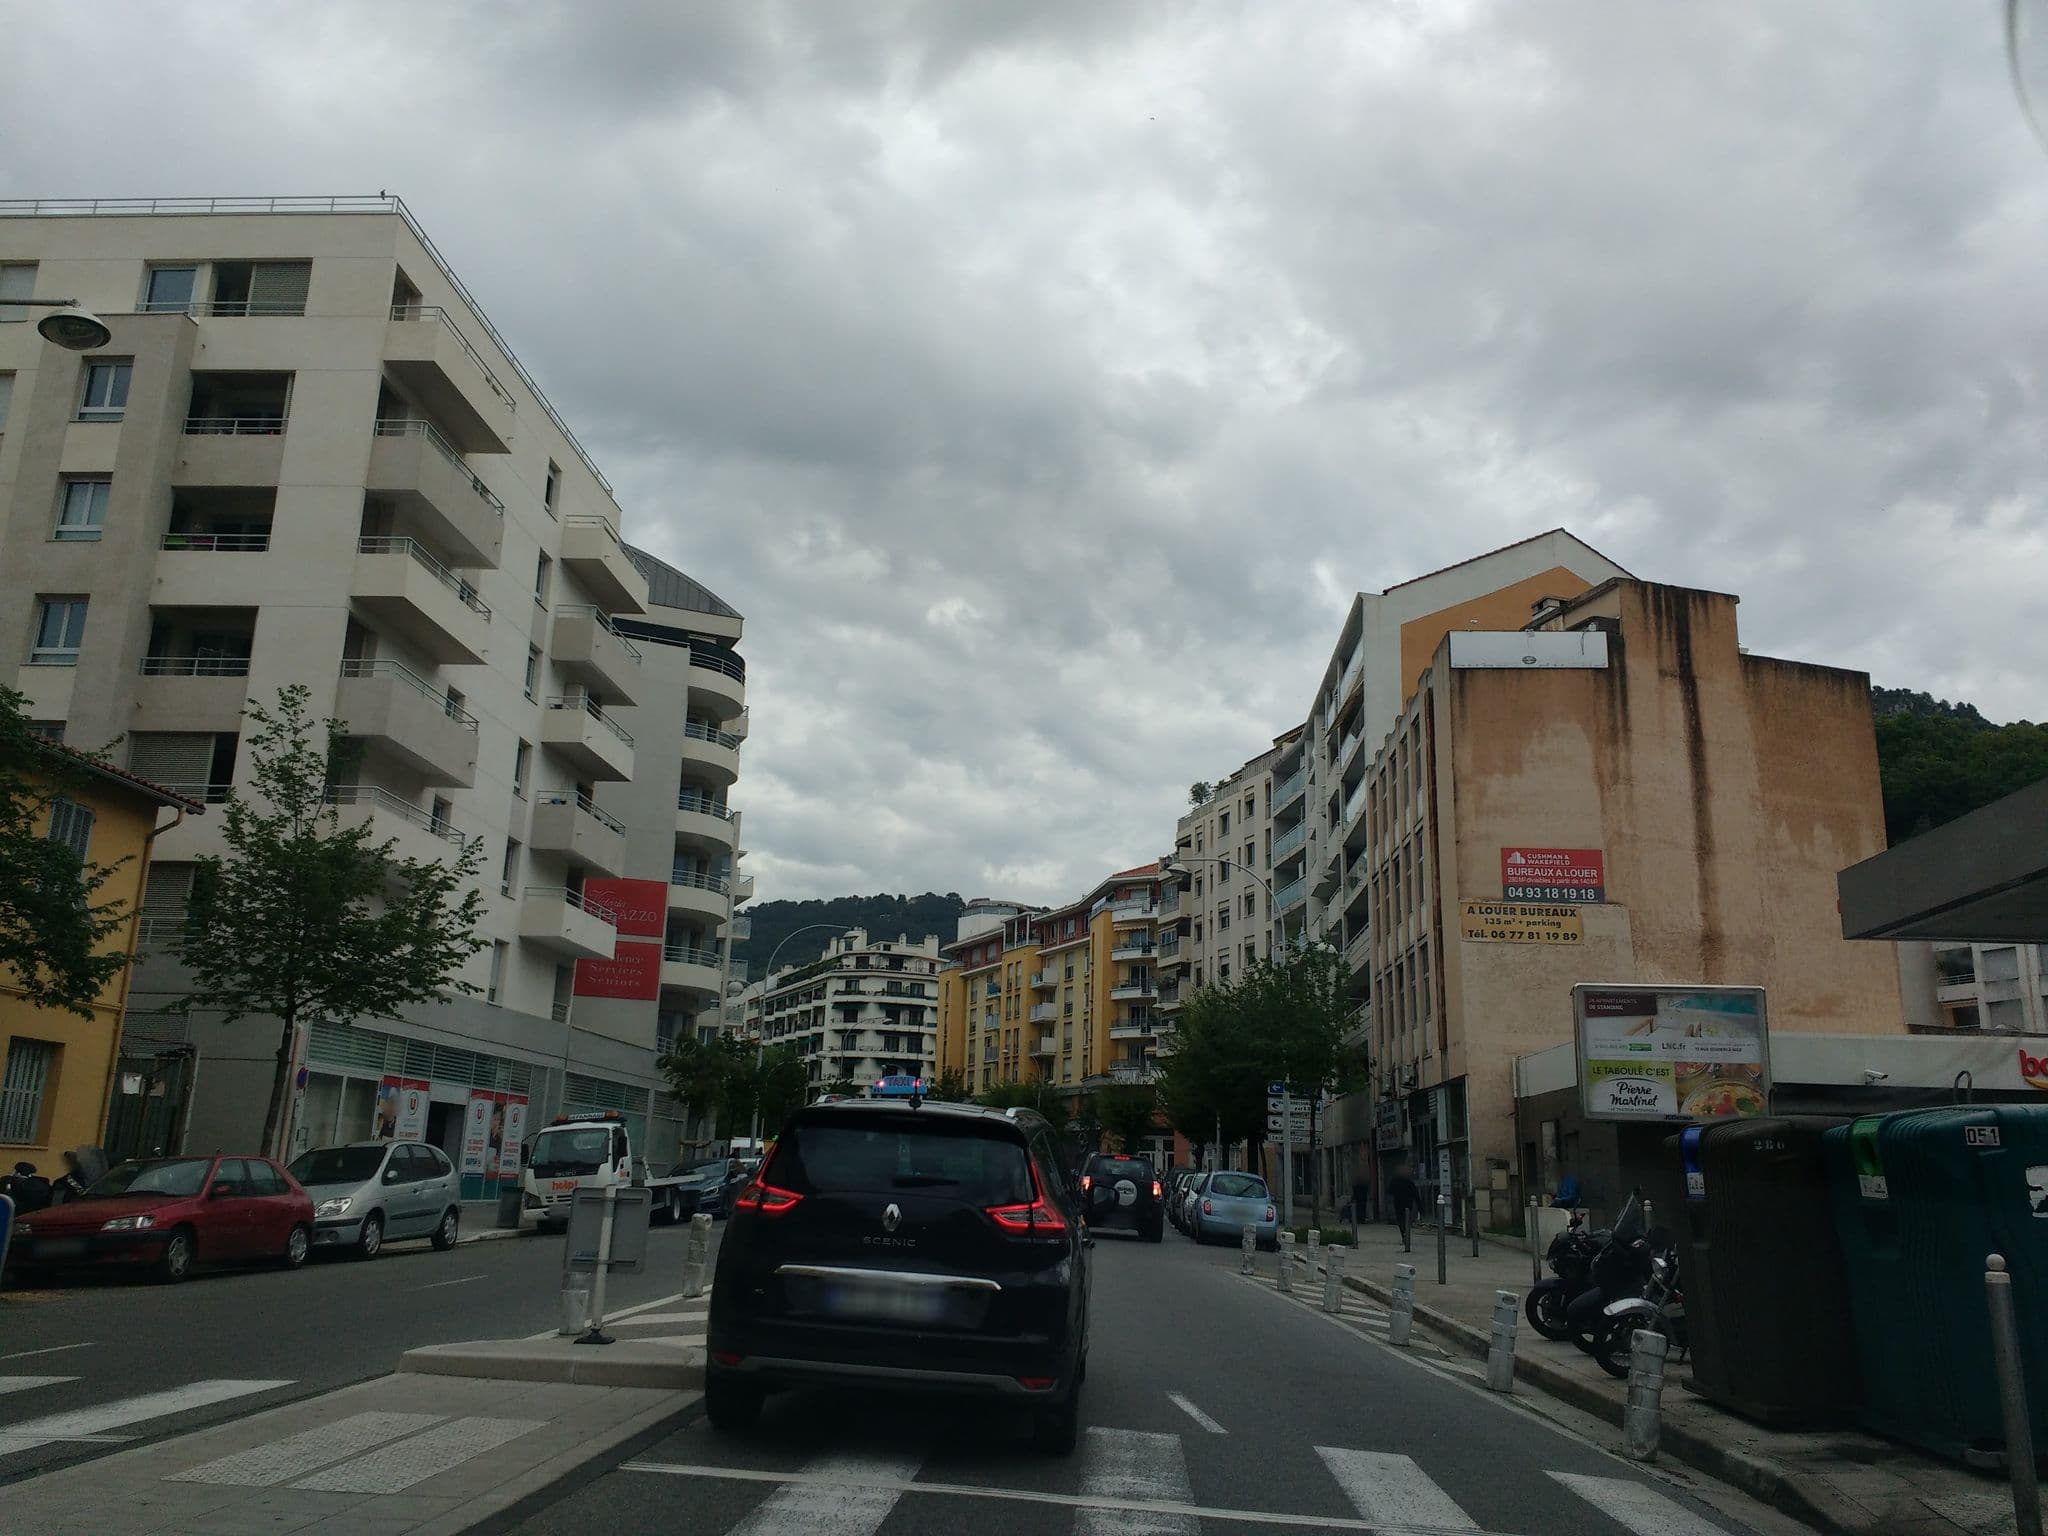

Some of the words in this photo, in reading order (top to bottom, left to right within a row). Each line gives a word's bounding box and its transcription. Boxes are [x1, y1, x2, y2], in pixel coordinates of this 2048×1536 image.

[1527, 853, 1563, 861] CUSHMAN
[1507, 867, 1554, 877] BUREAUX
[1555, 868, 1563, 877] A
[1564, 868, 1598, 878] LOUER
[1508, 886, 1523, 898] 04
[1526, 887, 1541, 898] 93
[1544, 887, 1559, 898] 18
[1562, 888, 1577, 899] 19
[1580, 888, 1595, 899] 18
[1467, 906, 1475, 914] A
[1479, 906, 1517, 916] LOUER
[1520, 907, 1577, 918] BUREAUX
[1526, 919, 1562, 928] parking
[1468, 929, 1488, 938] Tél.
[1491, 930, 1506, 939] 06
[1509, 931, 1525, 940] 77
[1527, 931, 1541, 940] 81
[1545, 932, 1559, 940] 19
[1562, 932, 1578, 941] 89
[1593, 1066, 1602, 1075] LE
[1604, 1066, 1643, 1076] TABOULÉ
[1645, 1067, 1670, 1077] C'EST
[1615, 1081, 1652, 1095] Pierre
[1609, 1094, 1658, 1107] Martinet
[863, 1236, 917, 1247] SCENIC
